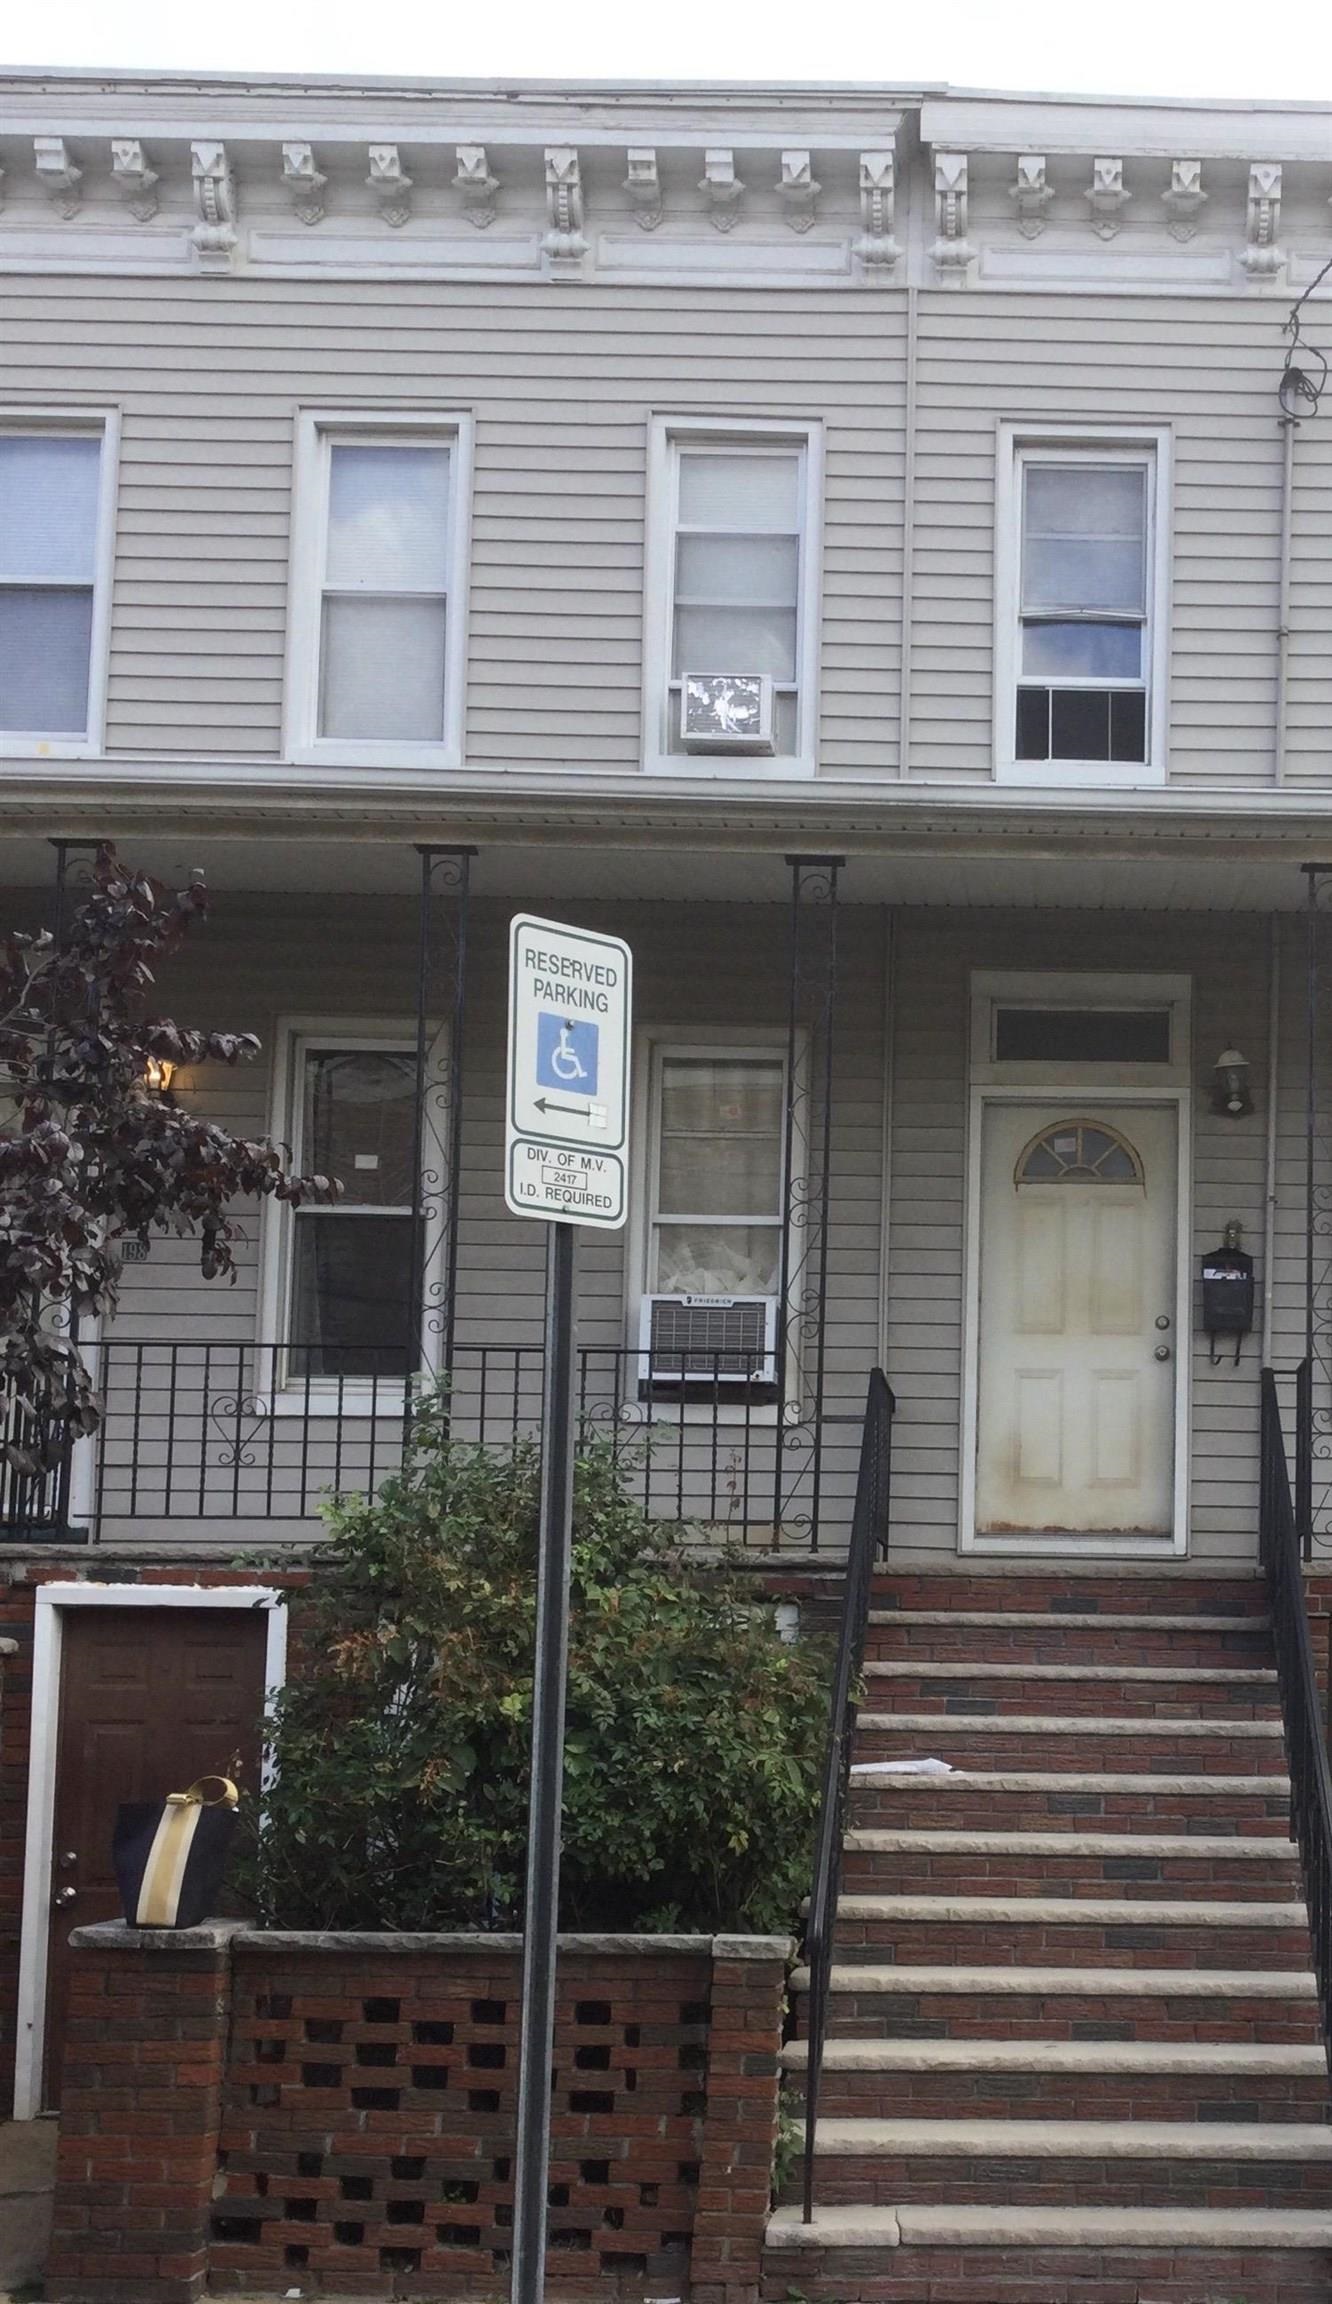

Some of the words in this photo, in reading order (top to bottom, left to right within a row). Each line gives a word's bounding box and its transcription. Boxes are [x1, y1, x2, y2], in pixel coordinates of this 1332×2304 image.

[525, 948, 617, 987] RESERVED
[534, 978, 609, 1013] PARKING
[527, 1147, 552, 1163] DIV.
[557, 1153, 575, 1166] OF
[581, 1157, 607, 1173] M.V.
[554, 1172, 577, 1185] 2417
[520, 1183, 539, 1197] I.D.
[545, 1187, 612, 1208] REQUIRED
